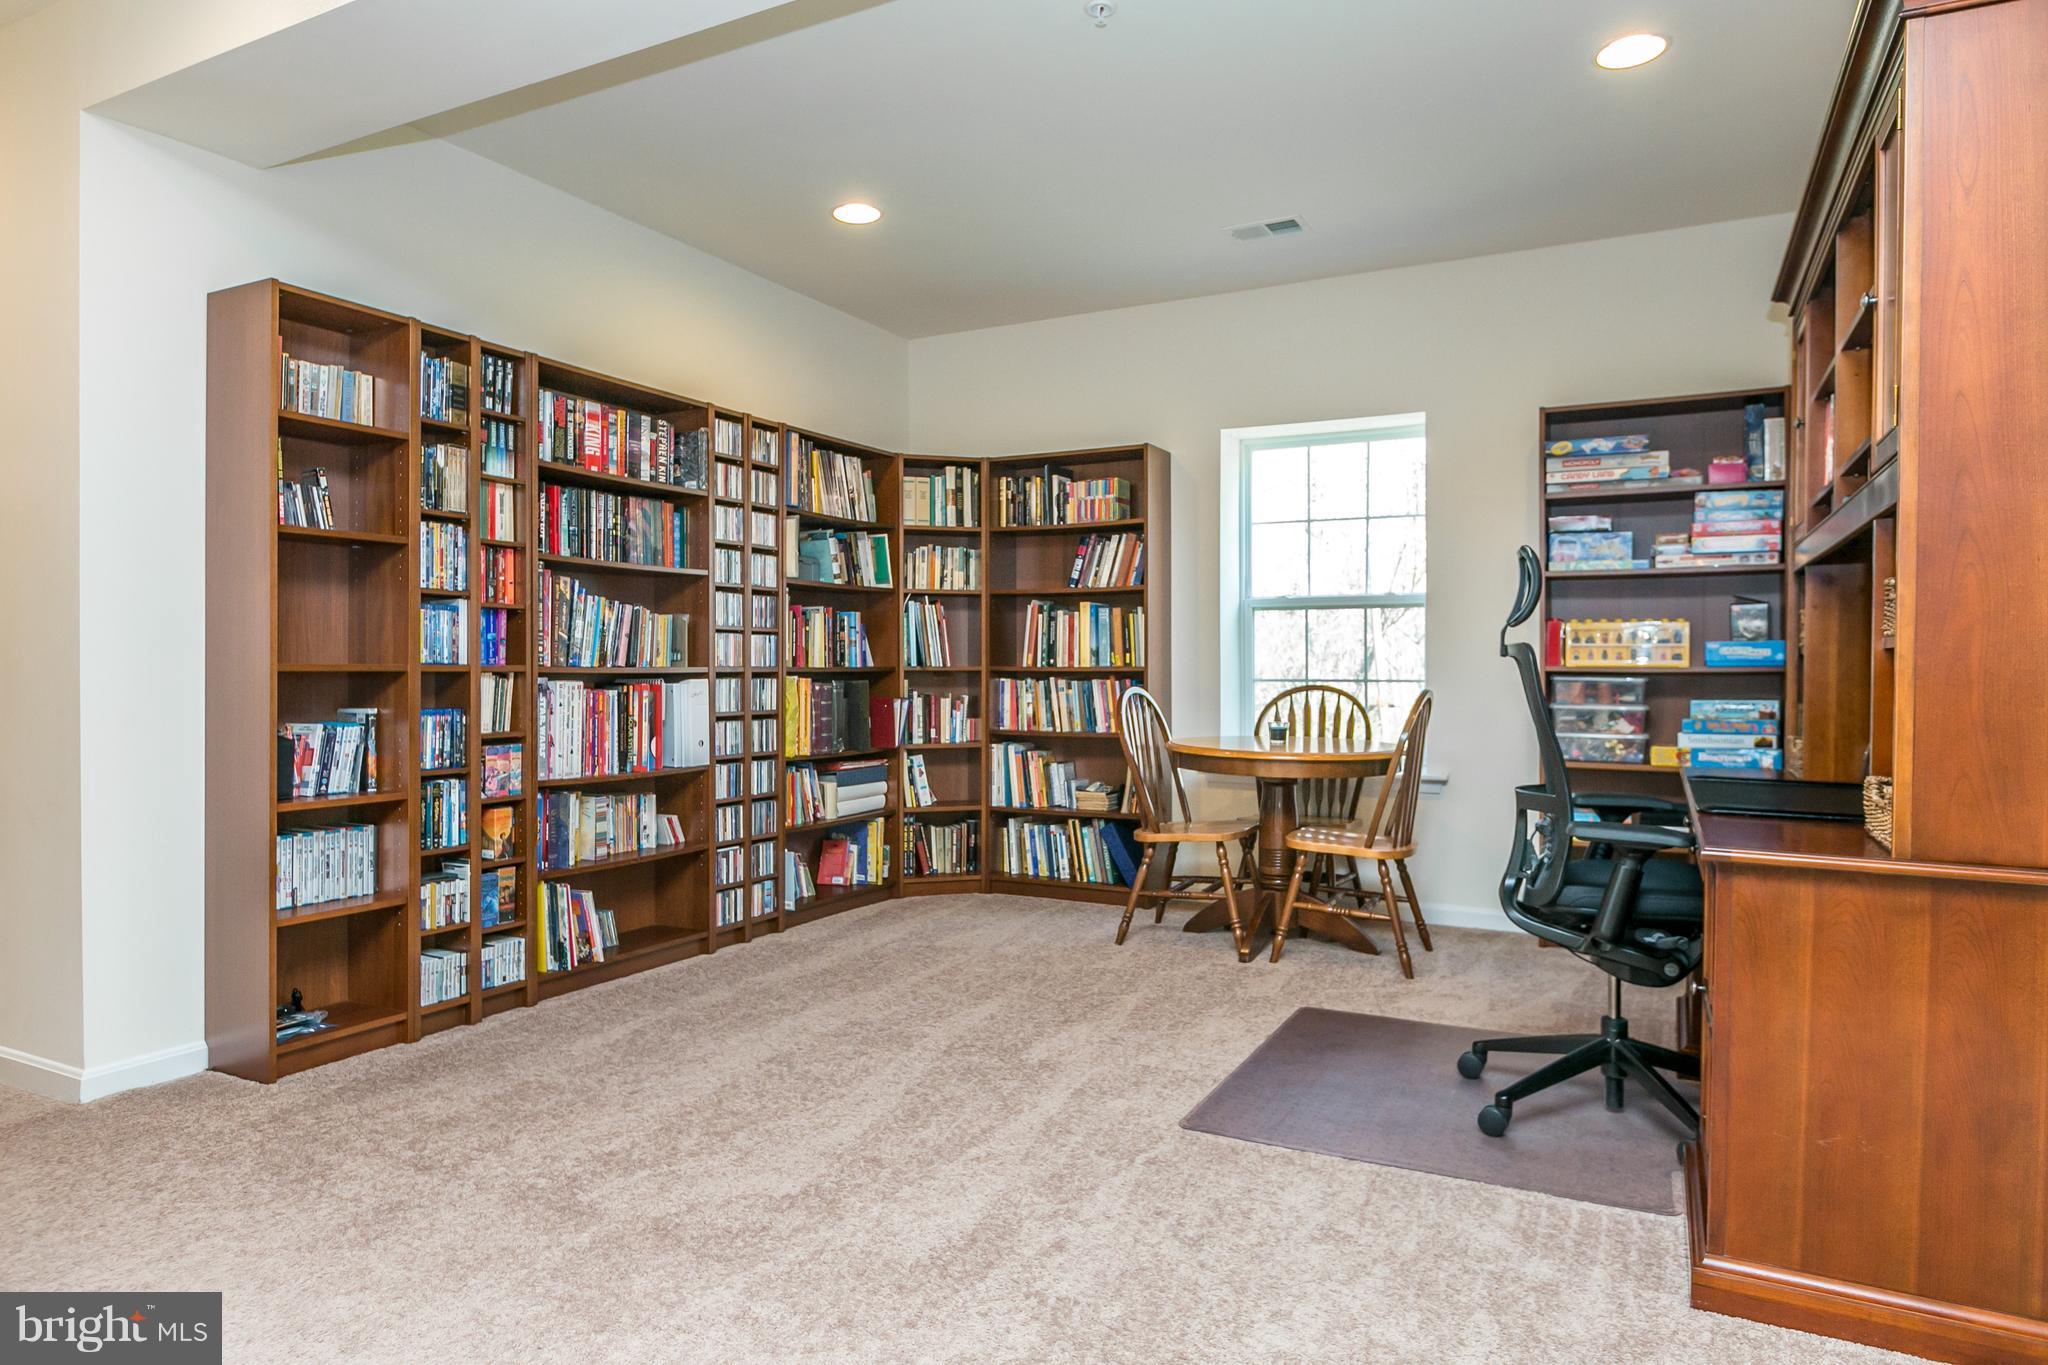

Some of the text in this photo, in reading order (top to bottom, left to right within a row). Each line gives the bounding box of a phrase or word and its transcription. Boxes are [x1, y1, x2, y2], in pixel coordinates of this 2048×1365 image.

[584, 421, 601, 457] KING
[657, 419, 668, 483] STEPHEN KIN
[1563, 459, 1600, 467] MONOPOLY
[1560, 470, 1616, 481] CANDY LAND
